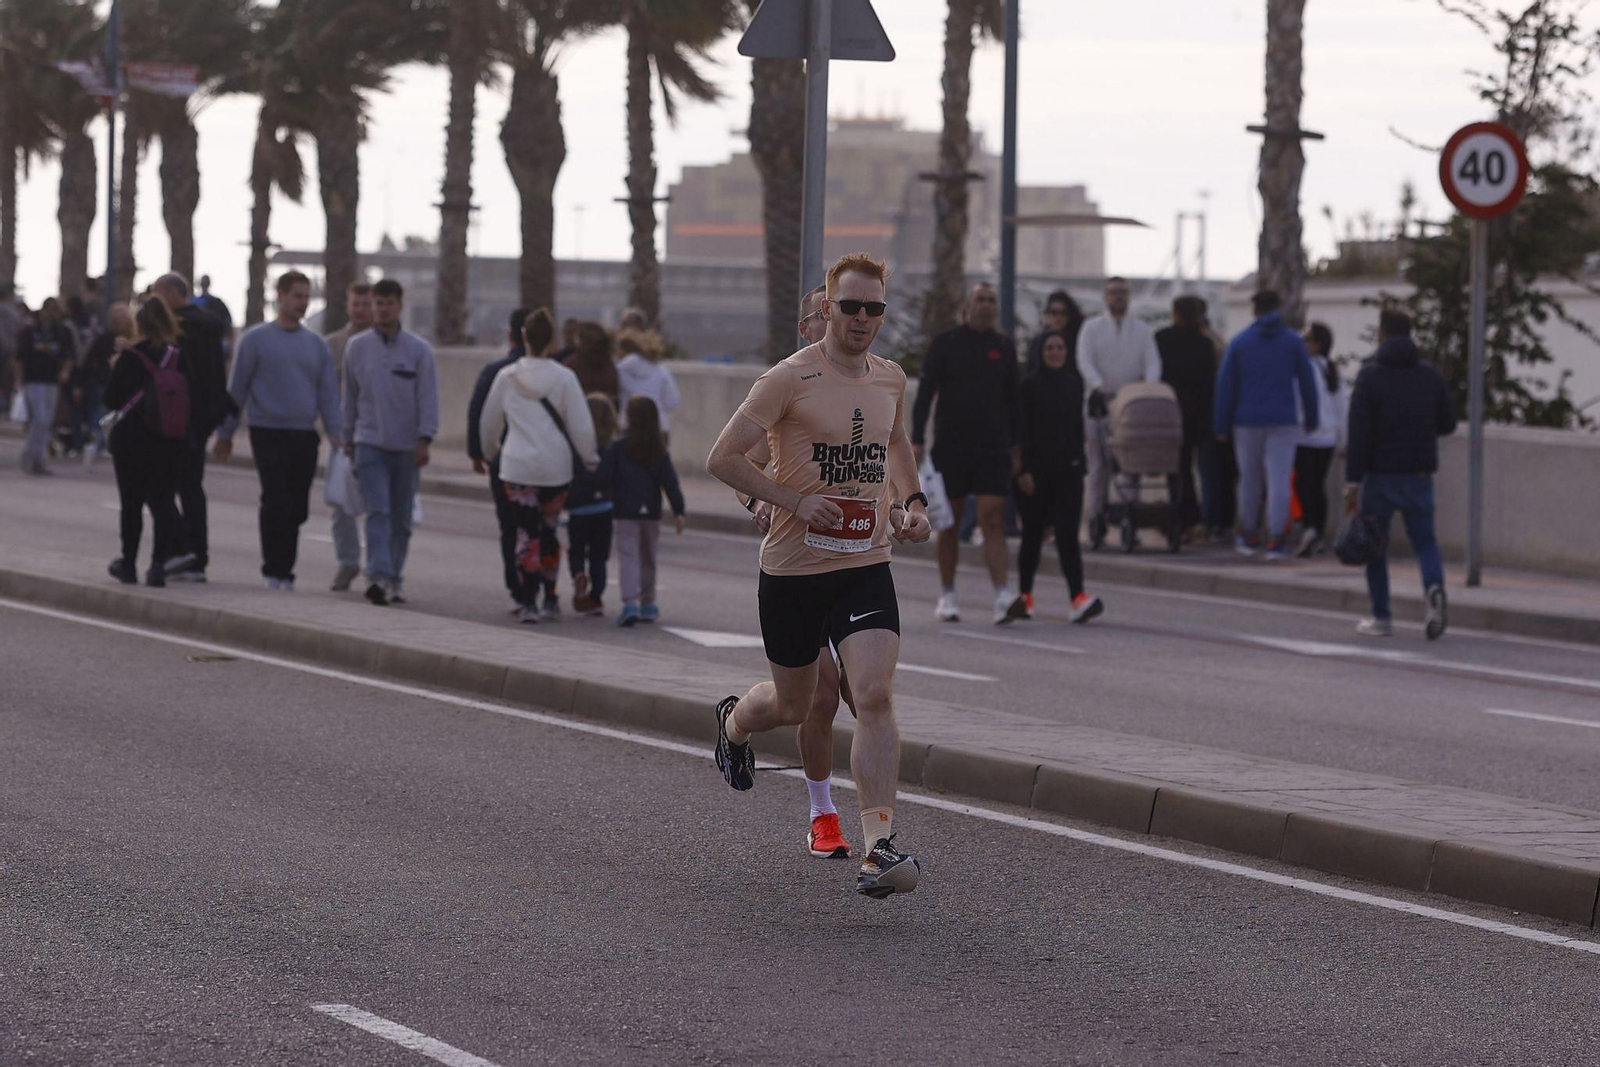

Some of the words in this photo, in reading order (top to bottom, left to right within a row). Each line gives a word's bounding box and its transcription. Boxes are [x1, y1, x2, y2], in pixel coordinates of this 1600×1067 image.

[1459, 150, 1505, 186] 40
[819, 462, 860, 486] RUN
[848, 518, 871, 531] 486
